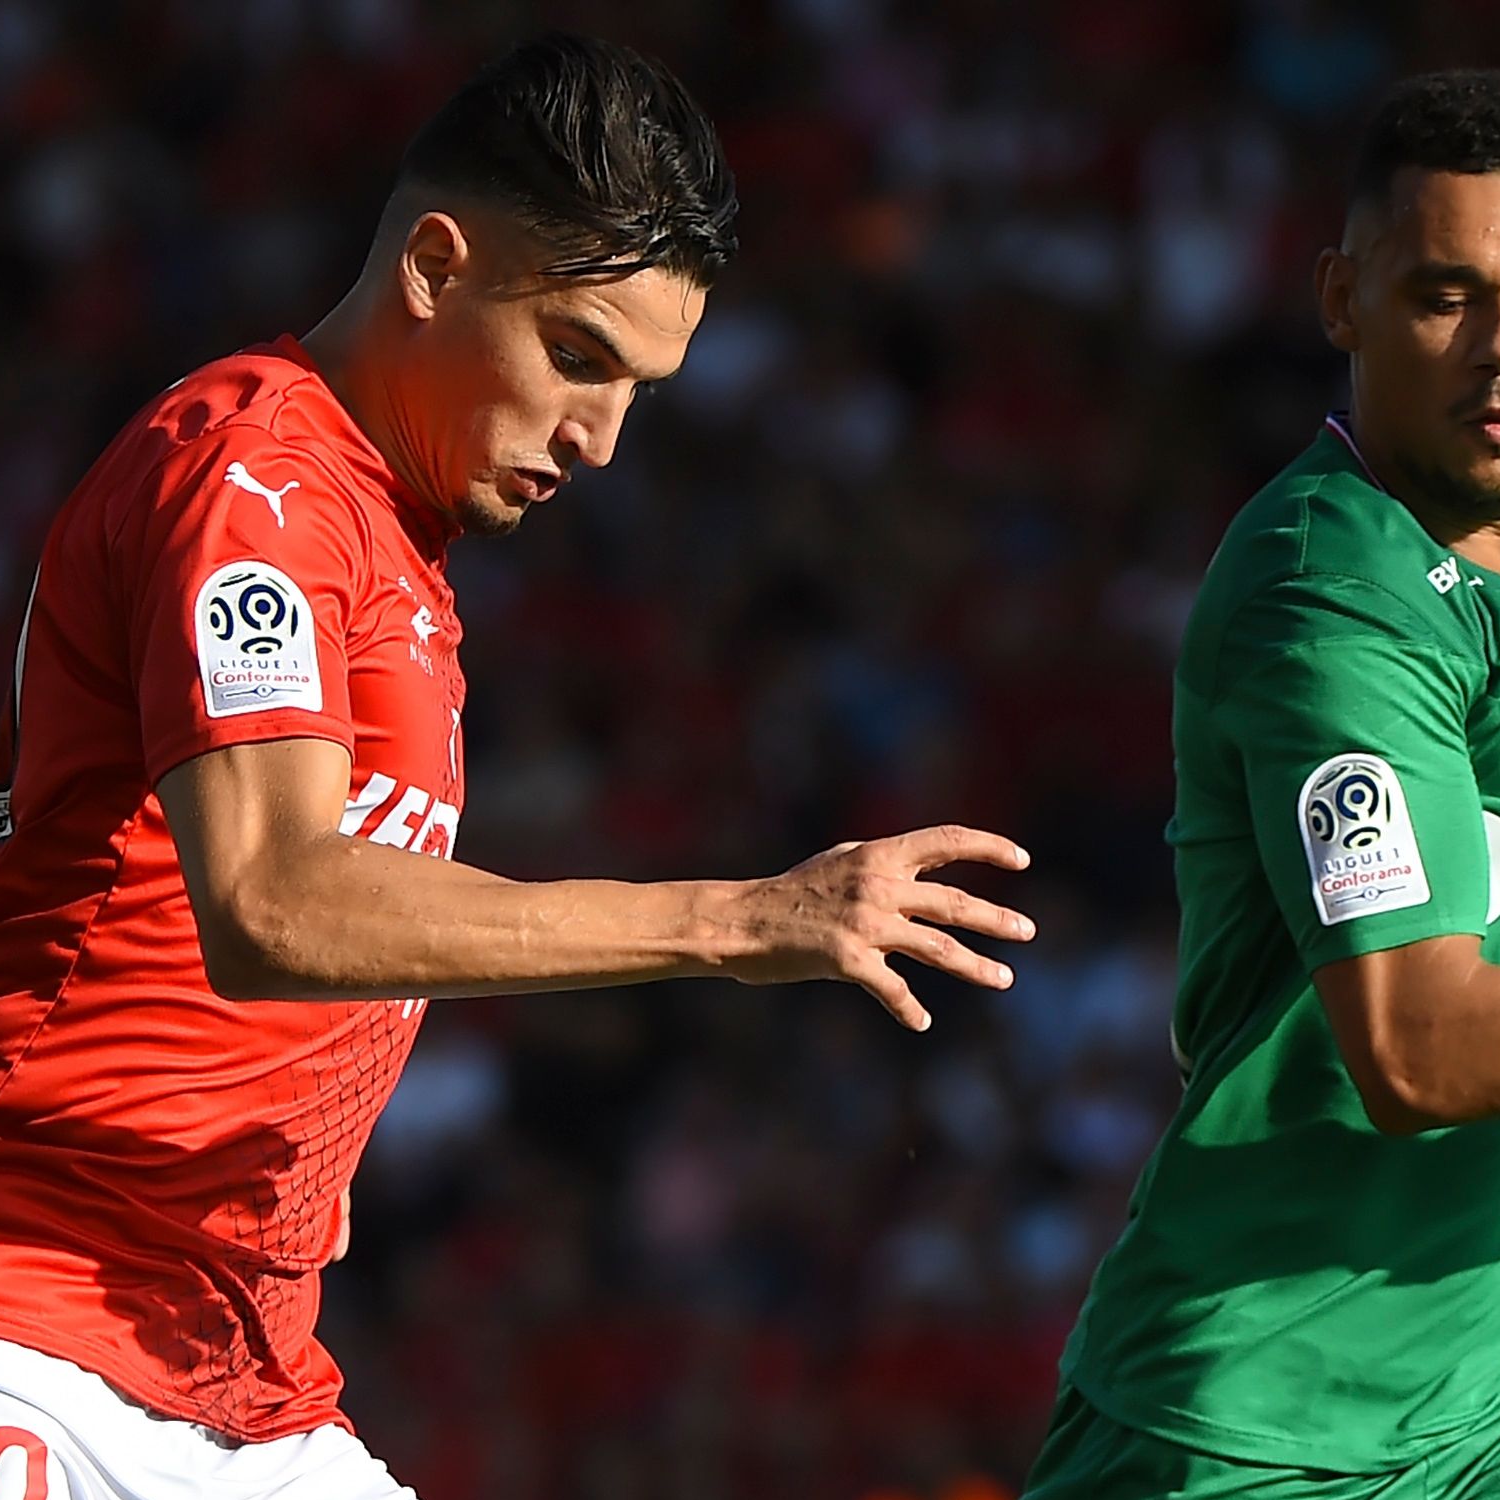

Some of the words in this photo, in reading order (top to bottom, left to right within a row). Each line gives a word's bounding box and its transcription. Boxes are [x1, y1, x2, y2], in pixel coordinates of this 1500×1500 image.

[220, 659, 280, 669] LIGUE
[213, 671, 310, 685] Conforama
[1324, 850, 1384, 874] LIGUE
[1322, 864, 1412, 893] Conforama
